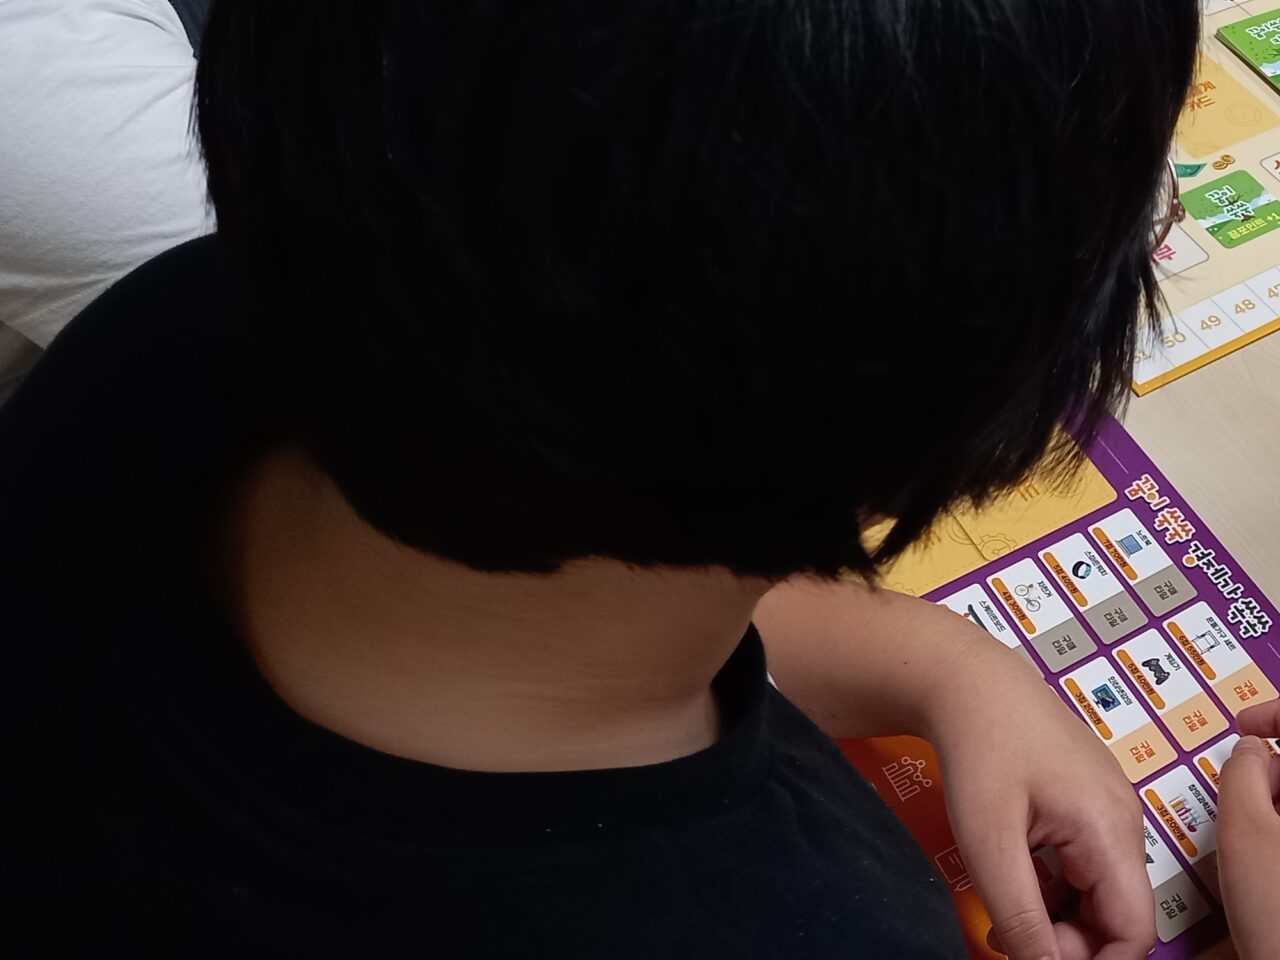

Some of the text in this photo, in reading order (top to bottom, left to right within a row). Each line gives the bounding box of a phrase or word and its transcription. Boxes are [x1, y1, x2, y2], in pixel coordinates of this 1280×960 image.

[1206, 184, 1235, 206] 꿈이
[1234, 298, 1256, 316] 48
[1200, 314, 1222, 332] 49
[1162, 331, 1187, 349] 50
[1136, 530, 1152, 546] 노트북
[1084, 550, 1108, 577] 스마트워치
[1110, 548, 1128, 569] 70만원
[1124, 473, 1272, 638] 꿈이 쑥쑥 경제가 쏙쏙
[1036, 580, 1054, 598] 자전거
[1060, 573, 1077, 594] 40만원
[1162, 580, 1179, 597] 구매
[1010, 600, 1027, 622] 30만원
[1112, 606, 1129, 624] 구매
[1062, 634, 1078, 651] 구매
[1164, 652, 1182, 672] 게임기
[1186, 642, 1206, 666] 55만원
[1136, 674, 1154, 696] 40만원
[1244, 680, 1260, 698] 구매
[1084, 704, 1103, 726] 20만원
[1192, 710, 1209, 728] 구매
[1140, 740, 1157, 758] 구매
[1166, 816, 1187, 841] 20만원
[1170, 894, 1188, 914] 구매
